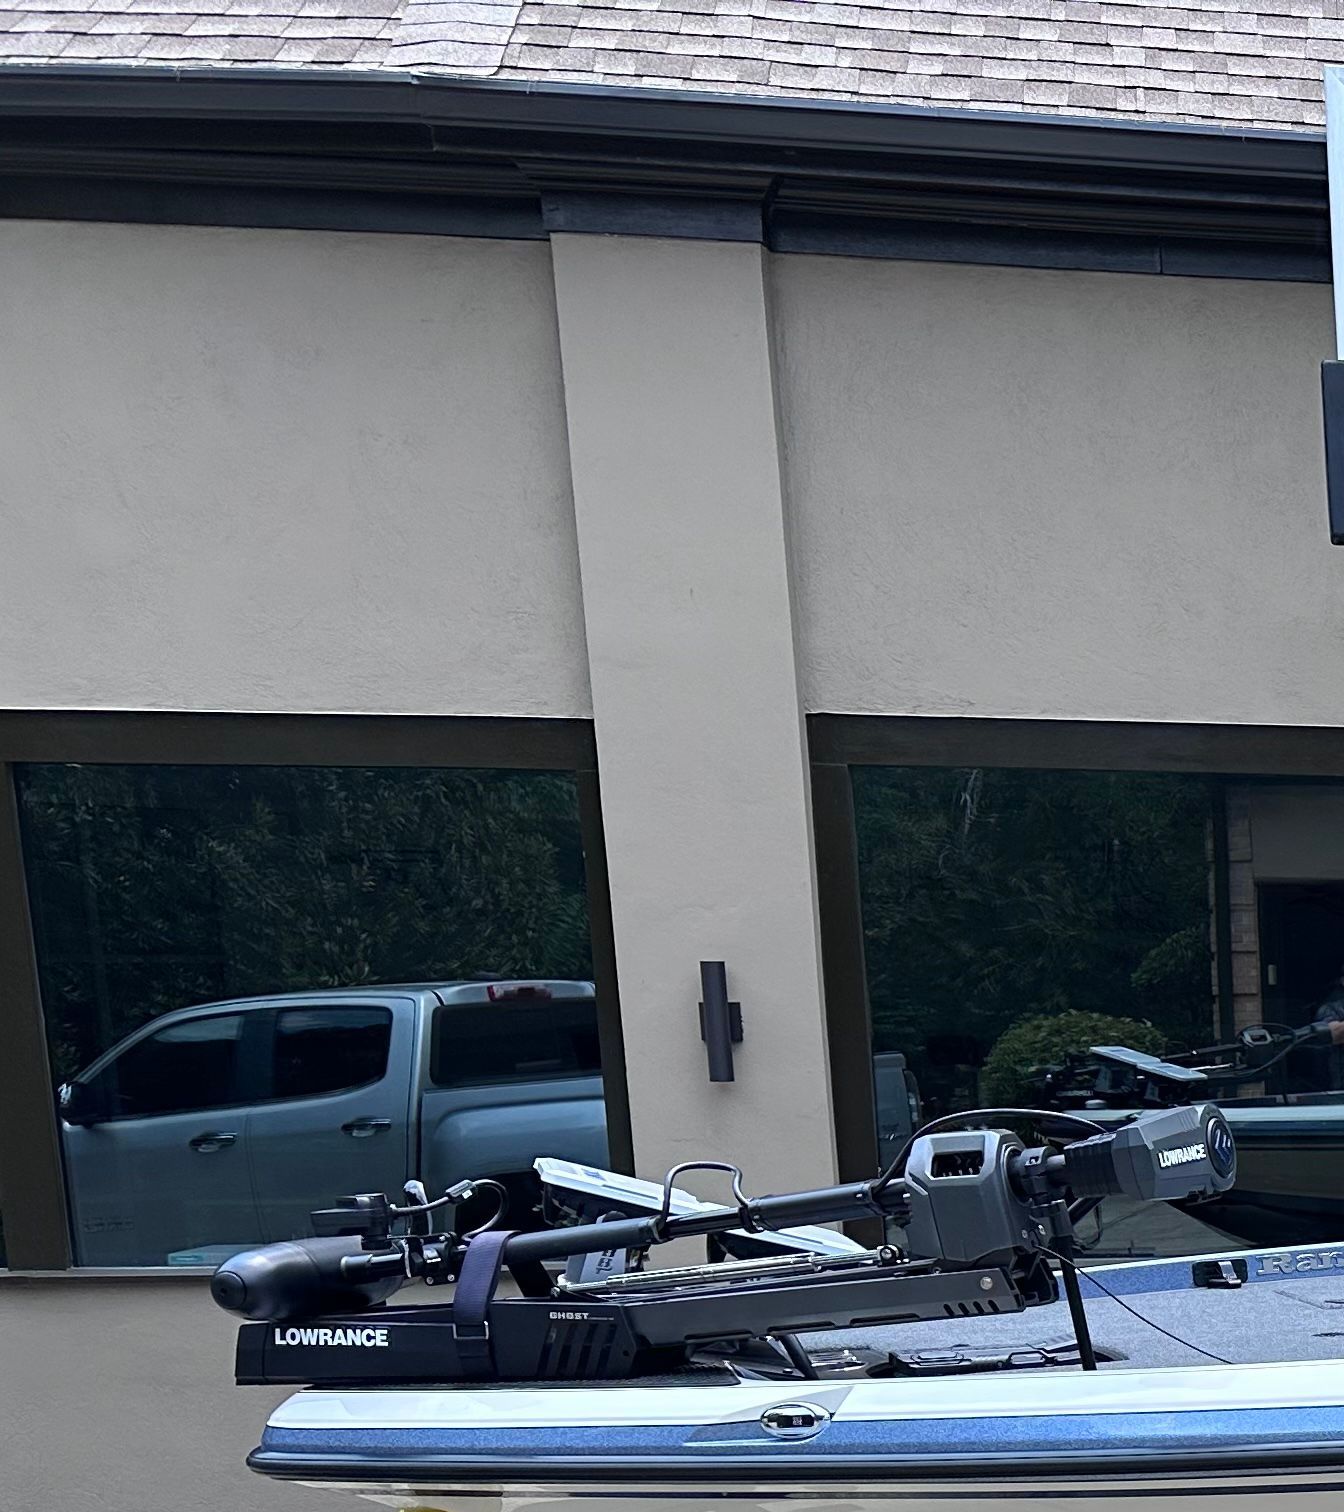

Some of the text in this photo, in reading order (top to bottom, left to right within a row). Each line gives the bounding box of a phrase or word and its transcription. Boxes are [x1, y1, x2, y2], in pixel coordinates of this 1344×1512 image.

[1158, 1143, 1207, 1168] LOWRANCE
[549, 1312, 590, 1320] GHOST
[274, 1327, 390, 1347] LOWRANCE
